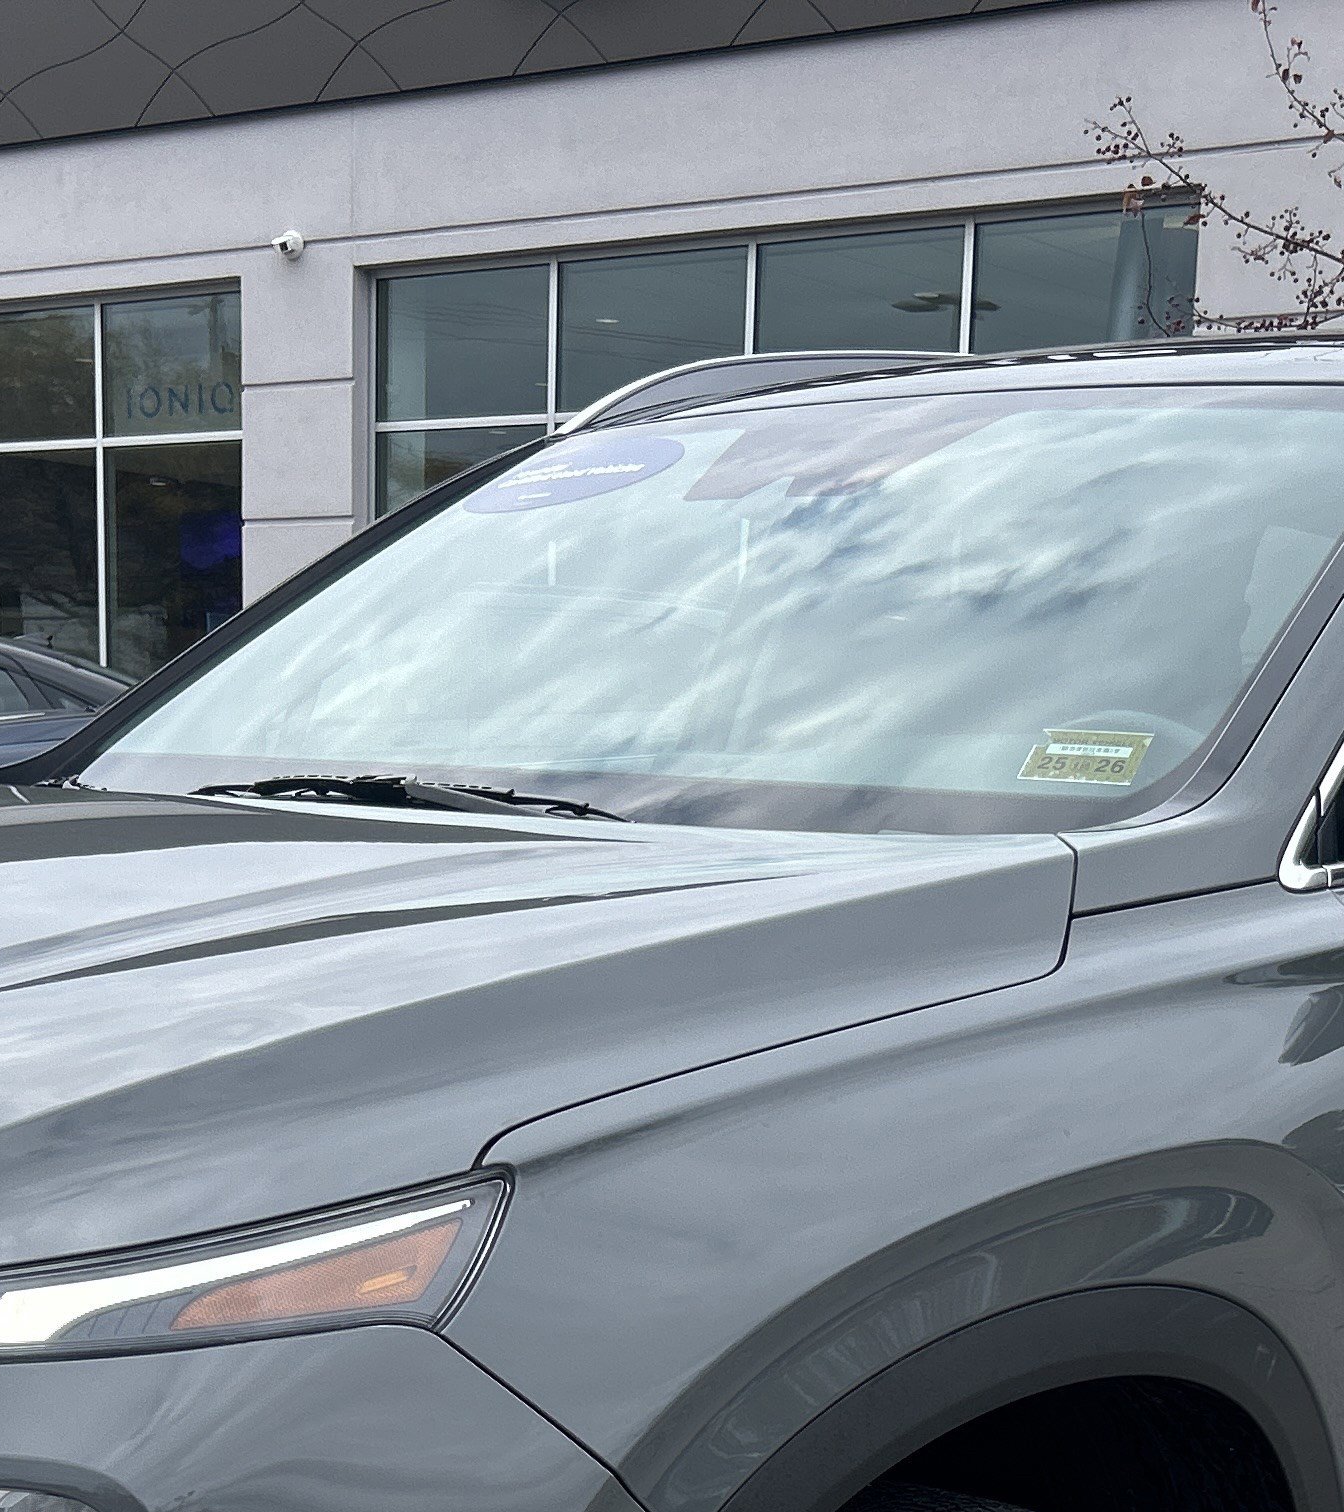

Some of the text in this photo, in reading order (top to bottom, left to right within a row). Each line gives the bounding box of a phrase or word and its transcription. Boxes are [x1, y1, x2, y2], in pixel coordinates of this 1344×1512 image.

[126, 381, 234, 419] IONIQ
[1036, 756, 1067, 771] 25
[1094, 758, 1126, 774] 26
